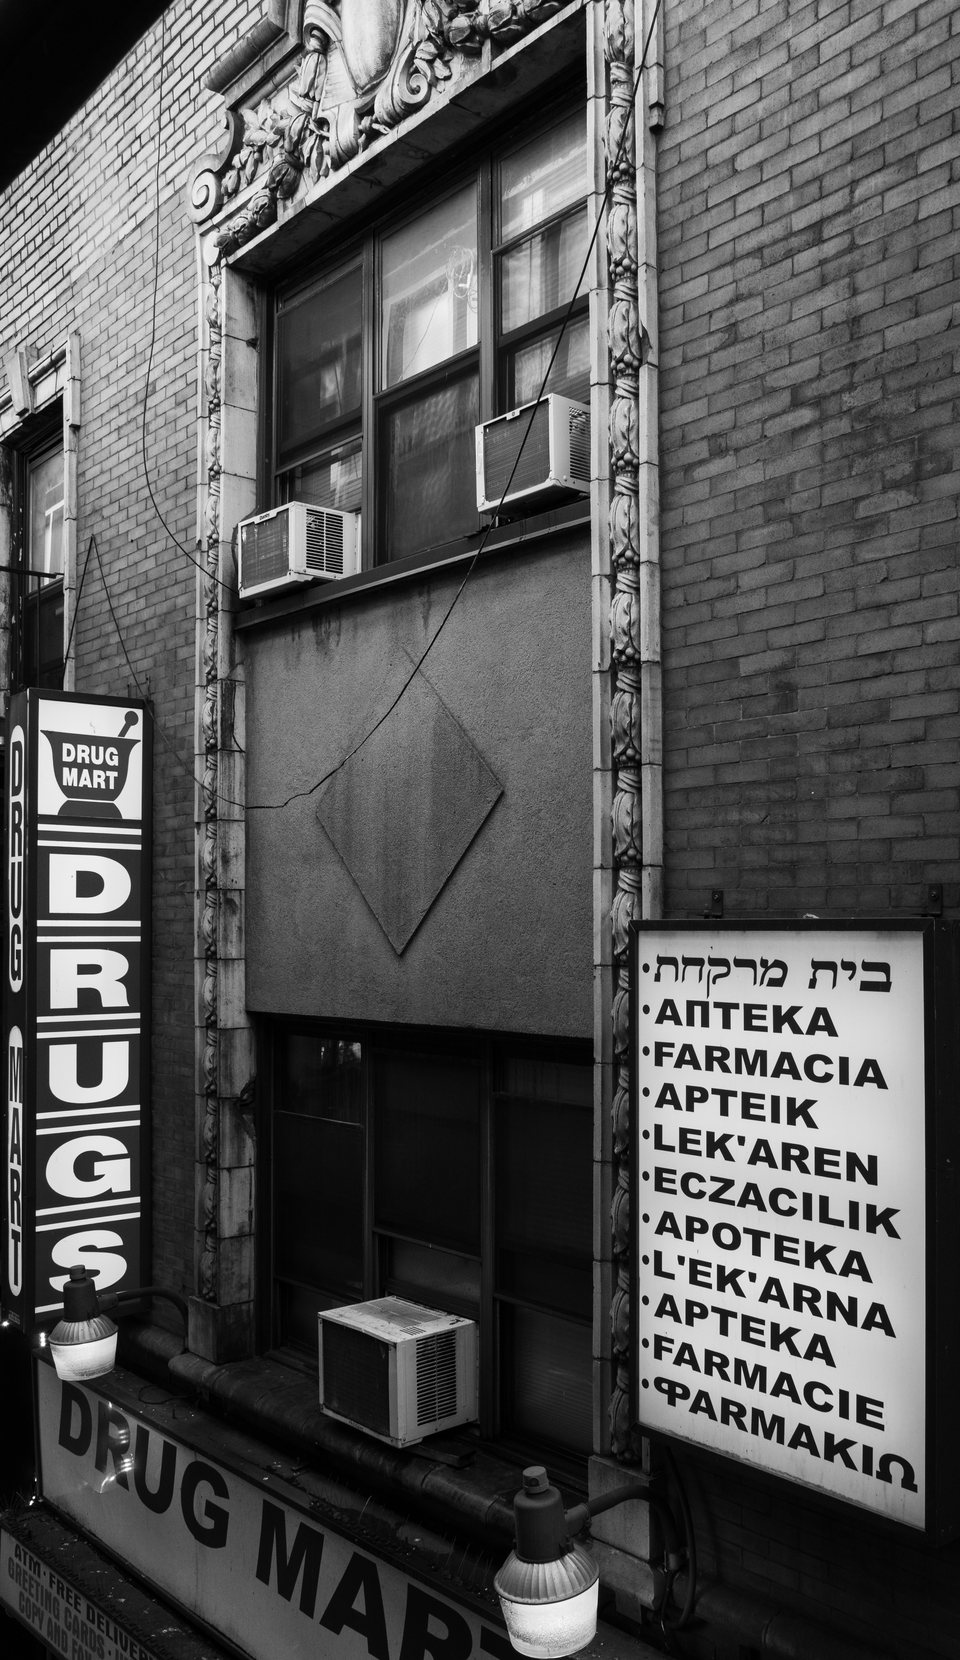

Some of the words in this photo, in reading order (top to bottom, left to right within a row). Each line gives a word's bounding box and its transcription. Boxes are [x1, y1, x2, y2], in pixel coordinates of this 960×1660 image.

[62, 743, 119, 766] DRUG
[62, 767, 119, 789] MART
[10, 740, 25, 982] DRUG
[654, 954, 788, 999] מרקחת
[809, 957, 892, 992] בית
[655, 999, 838, 1037] АПТЕКА
[46, 853, 132, 1293] DRUGS
[654, 1041, 889, 1089] FARMACIA
[654, 1083, 819, 1129] APTEIK
[8, 1046, 23, 1286] MART
[654, 1124, 878, 1186] LEK'AREN
[654, 1166, 902, 1239] ECZACILIK
[654, 1211, 873, 1284] APOTEKA
[653, 1250, 897, 1338] L'EK'ARNA
[654, 1293, 837, 1368] APTEKA
[653, 1334, 885, 1432] FARMACIE
[59, 1380, 230, 1550] DRUG
[8, 1557, 60, 1619] GREETING
[64, 1606, 105, 1659] CARDS
[14, 1543, 41, 1578] ATM
[49, 1575, 81, 1613] FREE
[19, 1590, 44, 1630] COPY
[47, 1616, 68, 1653] AND
